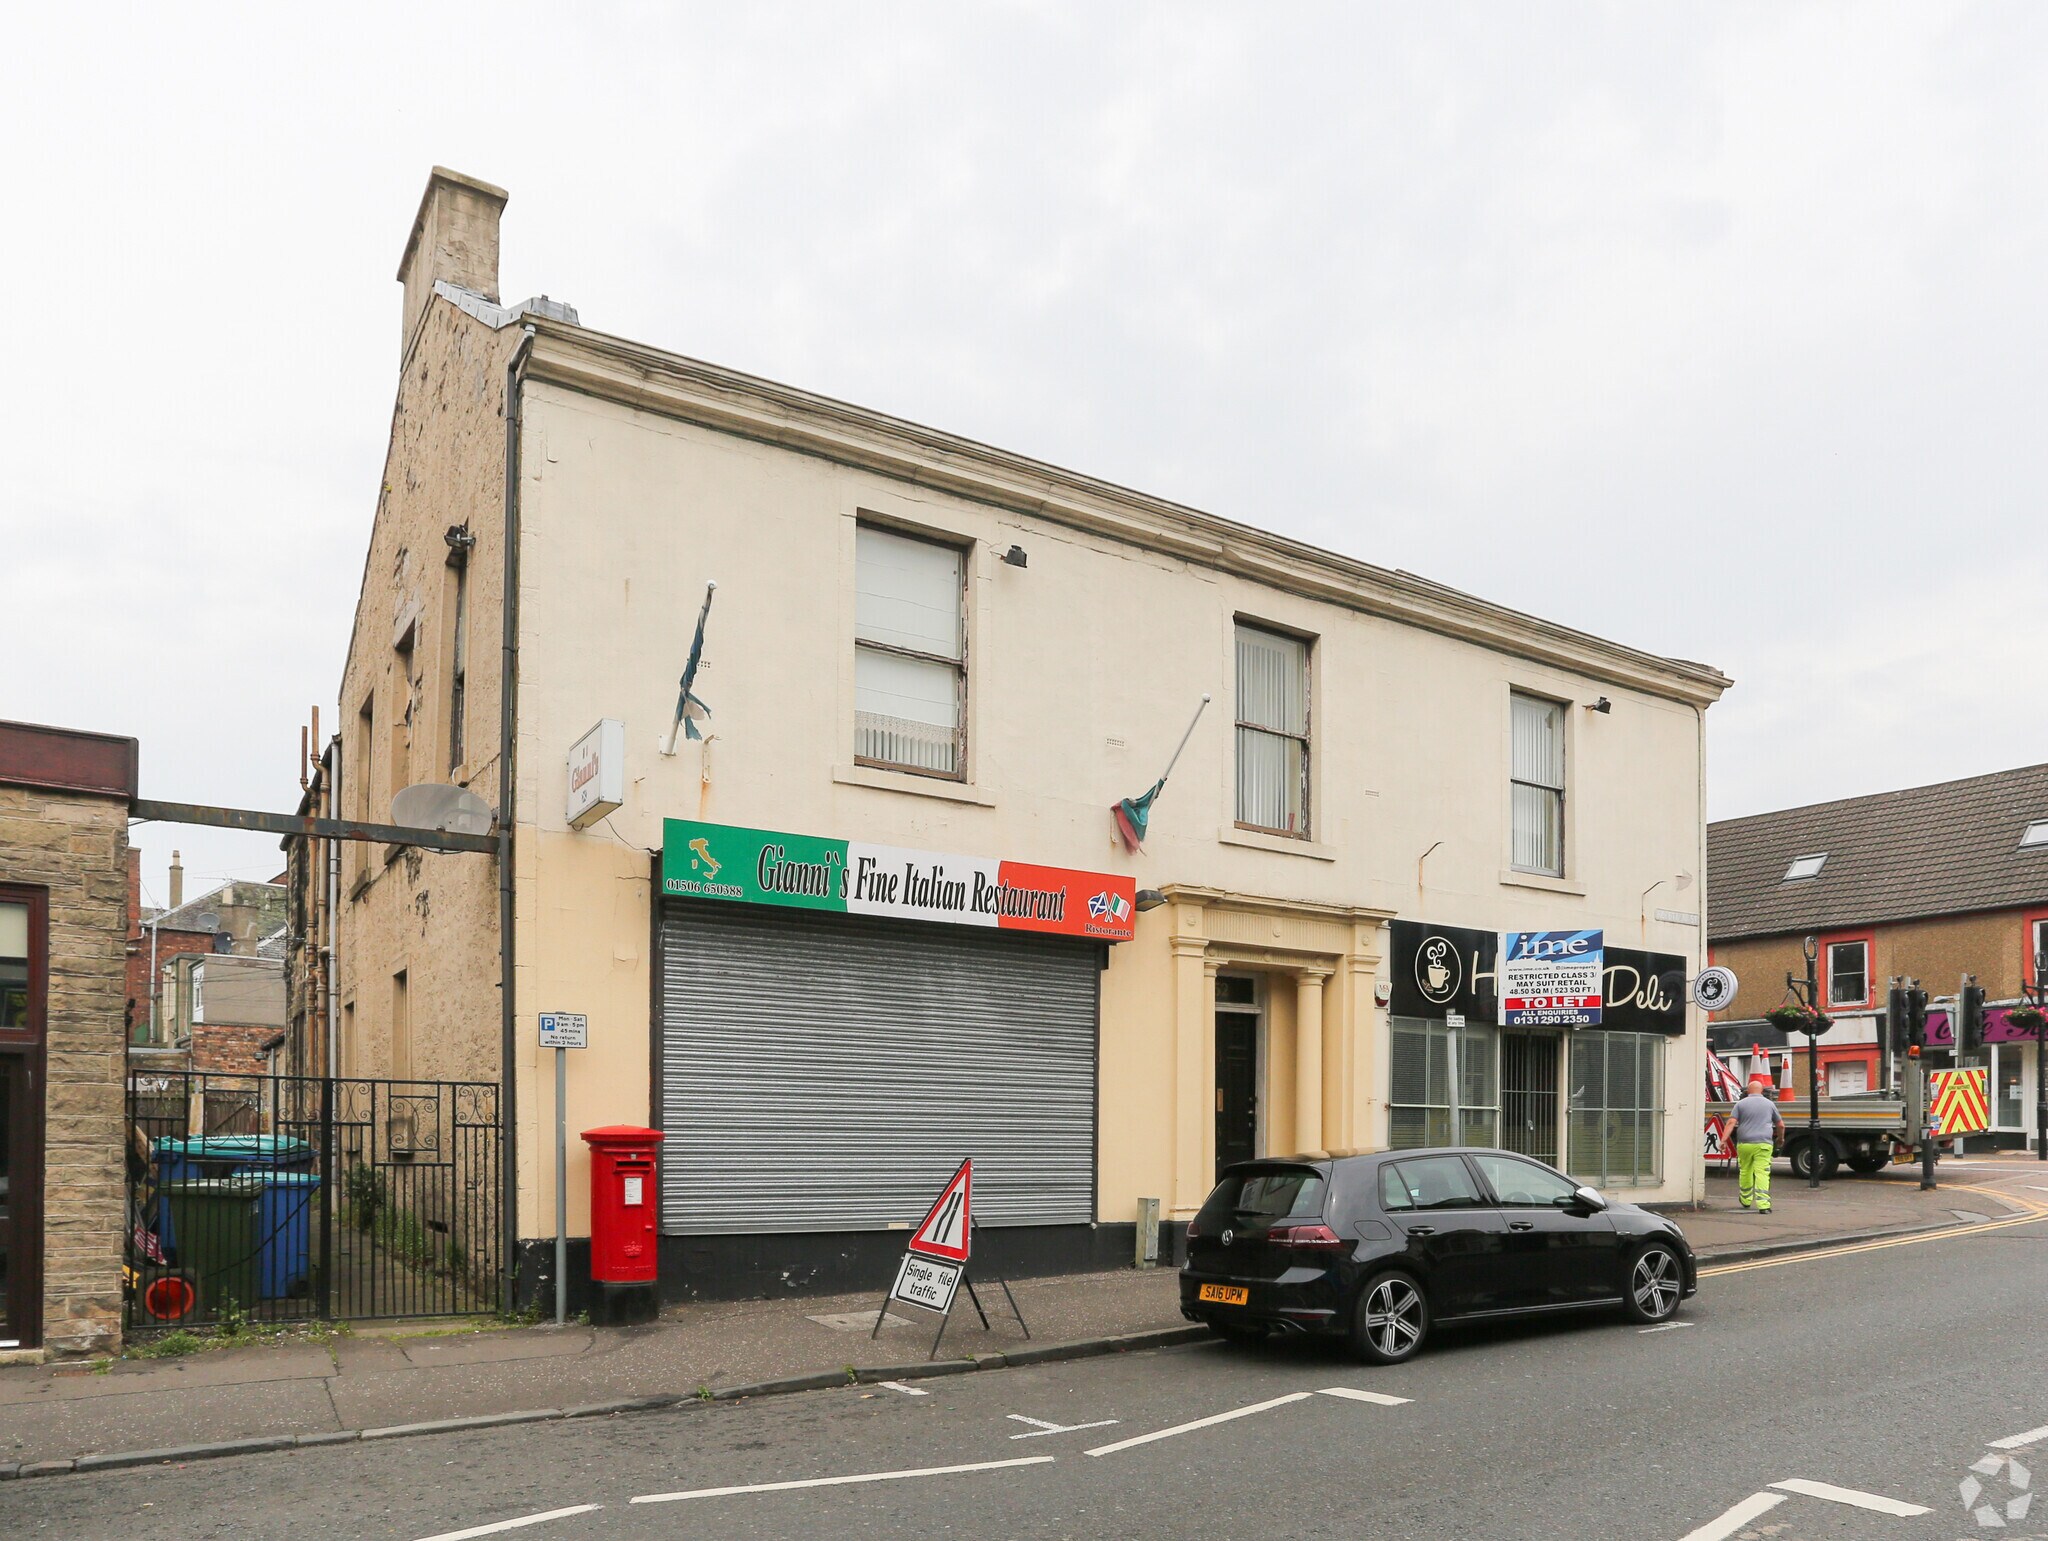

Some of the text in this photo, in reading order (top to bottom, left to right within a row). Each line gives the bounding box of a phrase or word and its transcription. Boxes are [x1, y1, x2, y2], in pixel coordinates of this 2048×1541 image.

[666, 877, 743, 898] 01506 650388
[854, 856, 898, 904] Fine
[902, 863, 966, 911] Italian
[970, 870, 1067, 922] Restaurant
[1085, 923, 1133, 938] Ristorante
[1519, 934, 1589, 956] ime
[1508, 973, 1559, 981] RESTRICTED
[1602, 963, 1672, 1012] Deli
[1521, 996, 1588, 1009] TO LET
[1562, 1015, 1590, 1023] 2350
[907, 1264, 953, 1287] Single file
[909, 1282, 937, 1300] traffic
[1205, 1286, 1243, 1301] SA16 UPM
